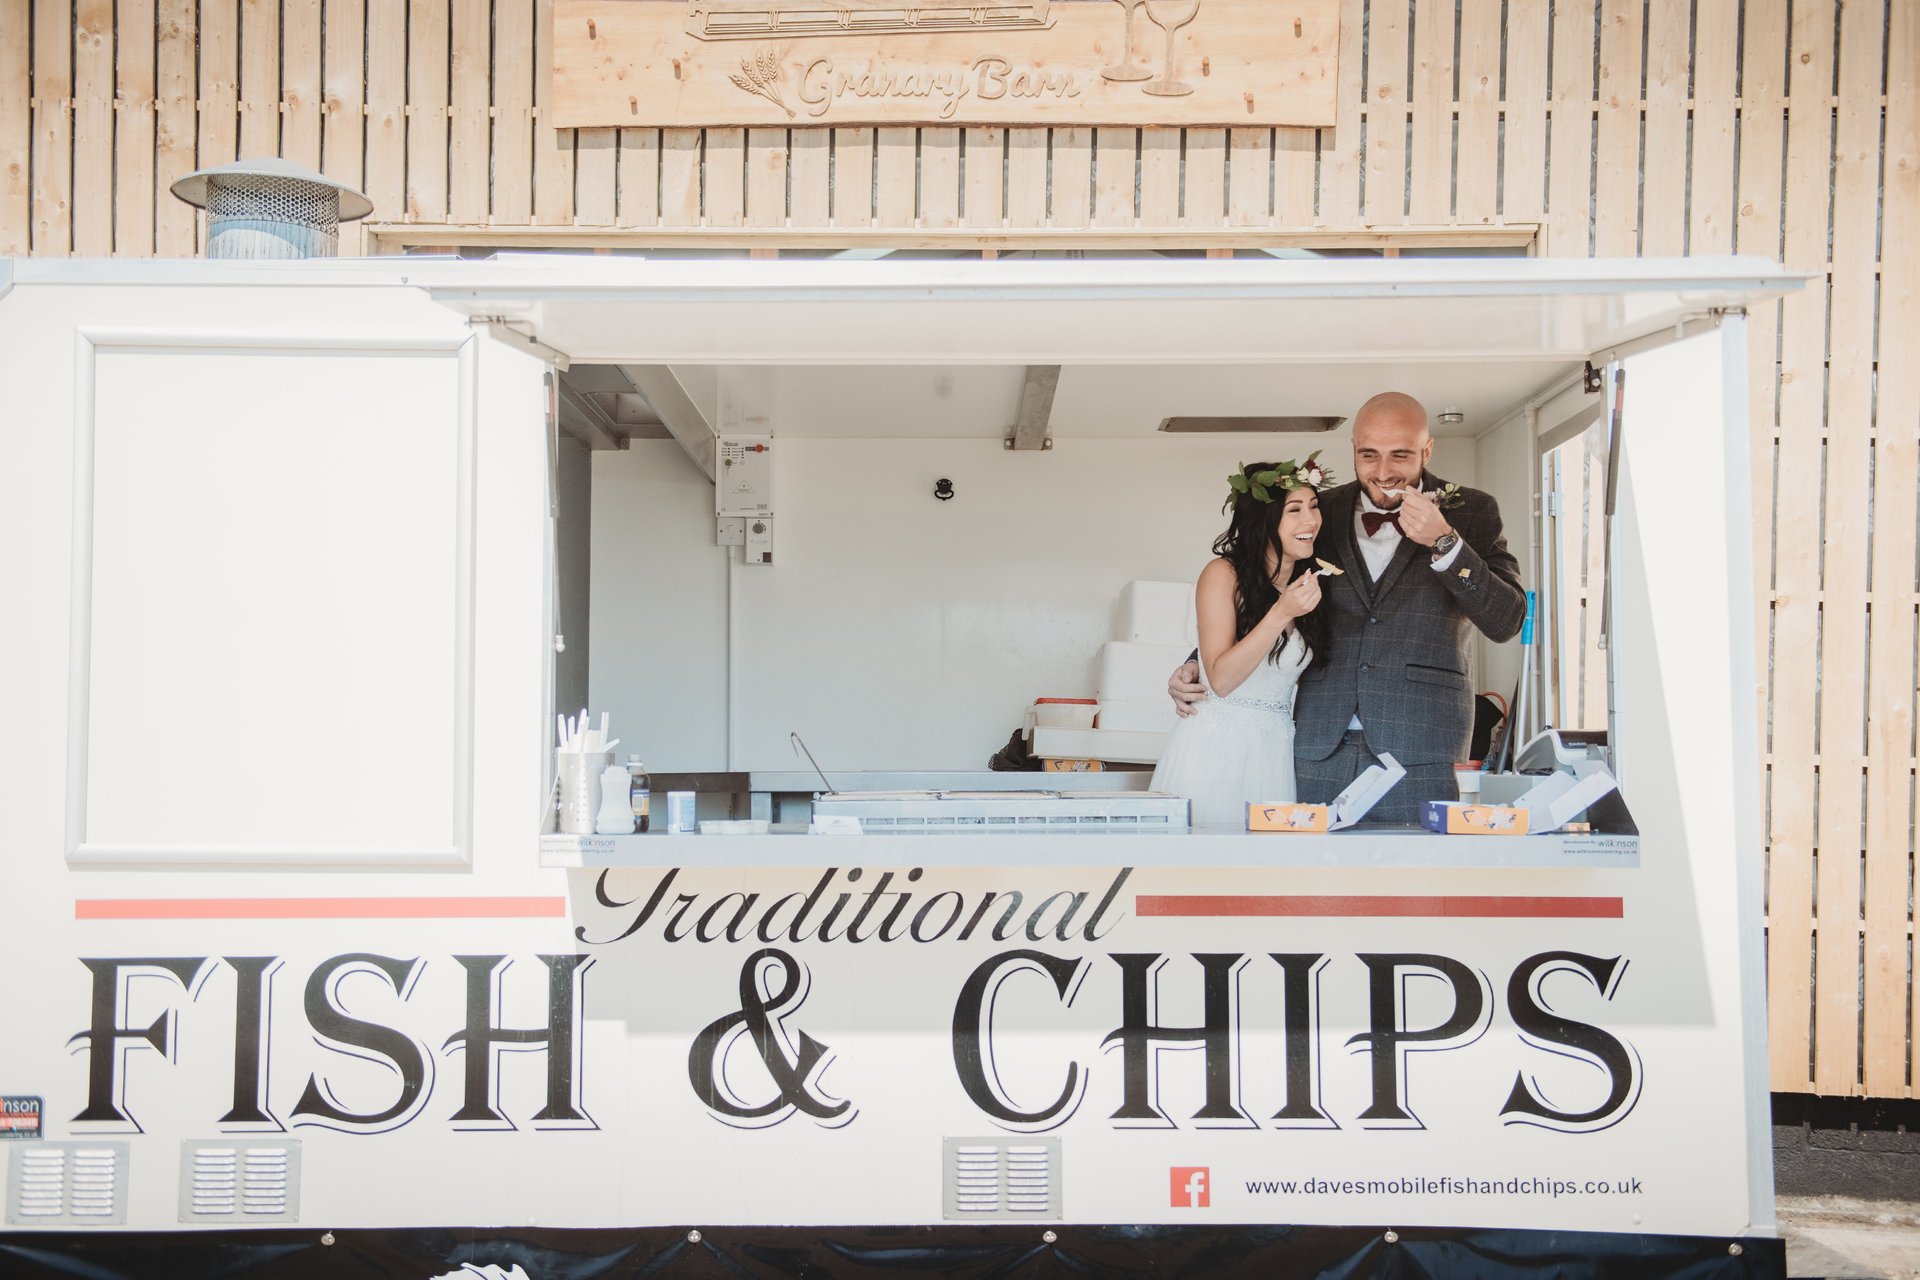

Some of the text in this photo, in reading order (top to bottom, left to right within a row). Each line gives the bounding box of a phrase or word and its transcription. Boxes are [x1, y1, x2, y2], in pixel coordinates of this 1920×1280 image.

[799, 54, 1081, 120] Granary Barn
[575, 867, 1134, 944] Traditional
[65, 948, 1644, 1134] FISH & CHIPS
[1245, 1177, 1644, 1198] www.davesmobilefishandchips.co.uk
